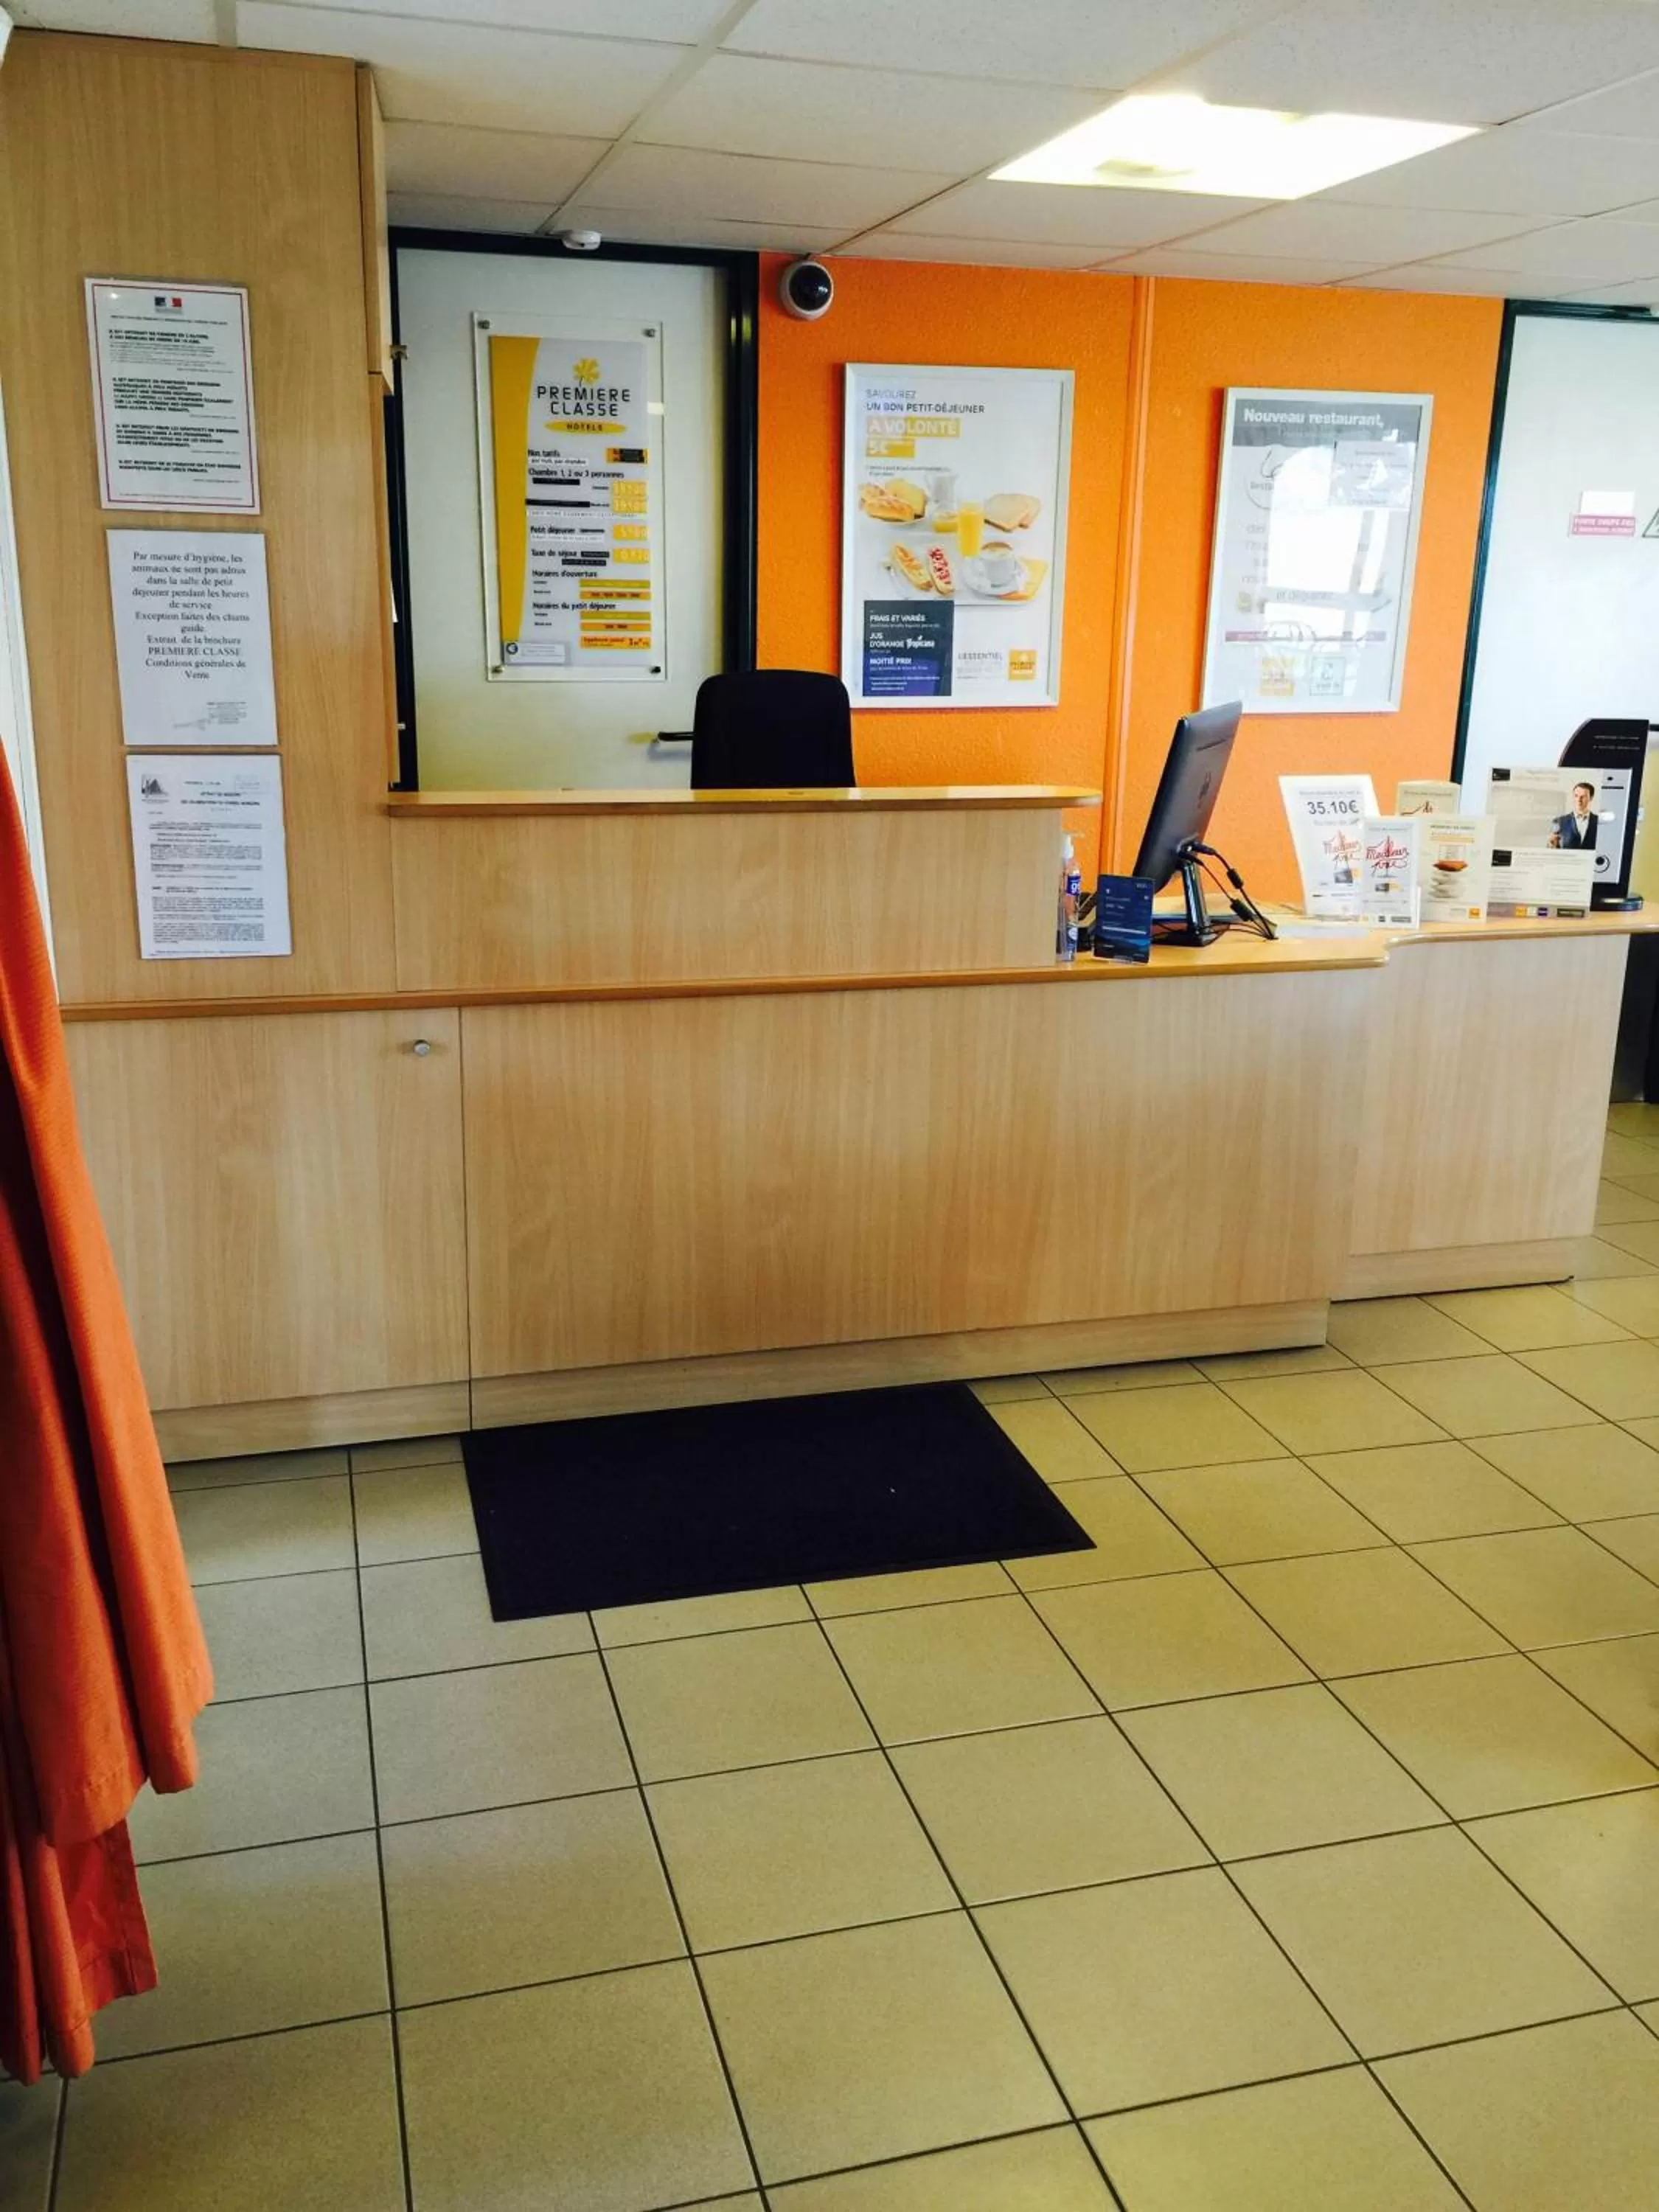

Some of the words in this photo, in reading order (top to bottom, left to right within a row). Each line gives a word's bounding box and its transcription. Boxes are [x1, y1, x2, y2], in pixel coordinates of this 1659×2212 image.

[537, 386, 630, 402] PREMIERE
[866, 389, 916, 399] SAVOUREZ
[550, 402, 619, 417] CLASSE
[883, 403, 903, 411] BON
[906, 401, 985, 414] PETIT-DÉJEUNER
[1244, 408, 1304, 424] Nouveau
[1309, 413, 1383, 428] restaurant,
[566, 423, 602, 431] HOTELS
[885, 417, 956, 435] VOLONTÉ
[528, 467, 557, 476] Chambre
[133, 552, 147, 560] Par
[231, 554, 243, 563] les
[204, 566, 218, 574] pas
[146, 576, 167, 585] dans
[169, 577, 178, 585] la
[180, 577, 198, 585] salle
[201, 577, 212, 585] de
[214, 577, 233, 587] petit
[171, 588, 206, 598] pendant
[207, 588, 220, 597] les
[221, 589, 249, 598] heures
[571, 602, 588, 611] petit
[135, 612, 179, 622] Exception
[206, 613, 220, 621] des
[147, 635, 176, 644] Extrait
[181, 636, 192, 644] de
[195, 636, 202, 644] la
[204, 636, 241, 644] brochure
[148, 647, 200, 655] PREMIERE
[203, 647, 240, 655] CLASSE
[145, 658, 193, 667] Conditions
[185, 670, 209, 679] Vente
[1307, 800, 1359, 815] 35.10€
